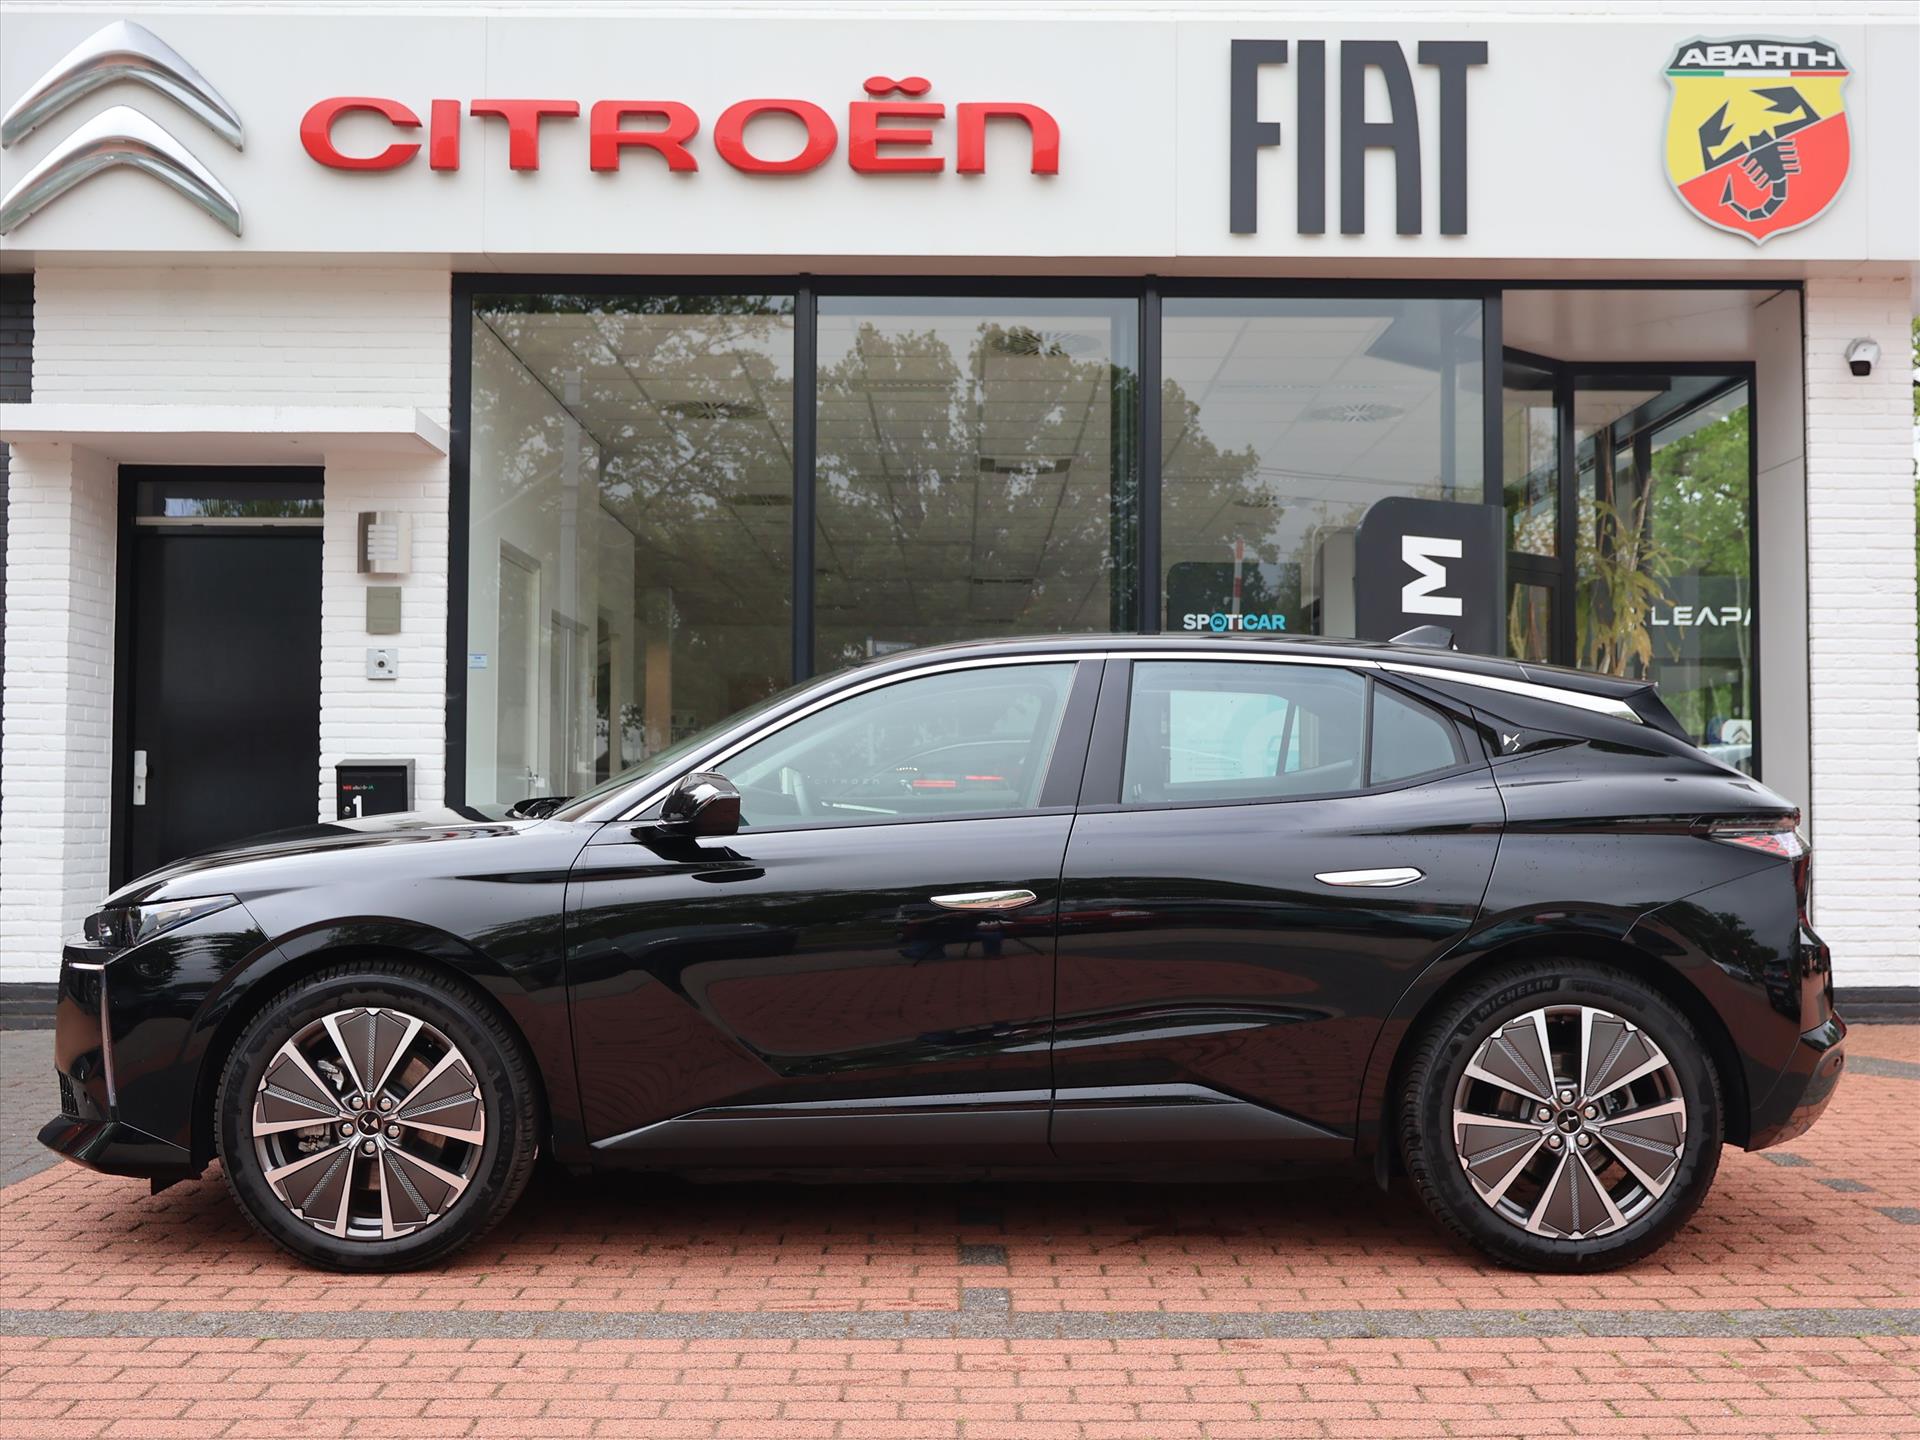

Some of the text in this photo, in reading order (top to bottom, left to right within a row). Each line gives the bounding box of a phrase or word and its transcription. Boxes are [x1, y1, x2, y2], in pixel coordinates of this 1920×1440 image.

[1678, 44, 1836, 66] ABARTH
[300, 75, 1061, 175] CITROËN
[1230, 39, 1488, 235] FIAT
[353, 794, 362, 818] 1
[1479, 978, 1555, 1016] MICHELIN
